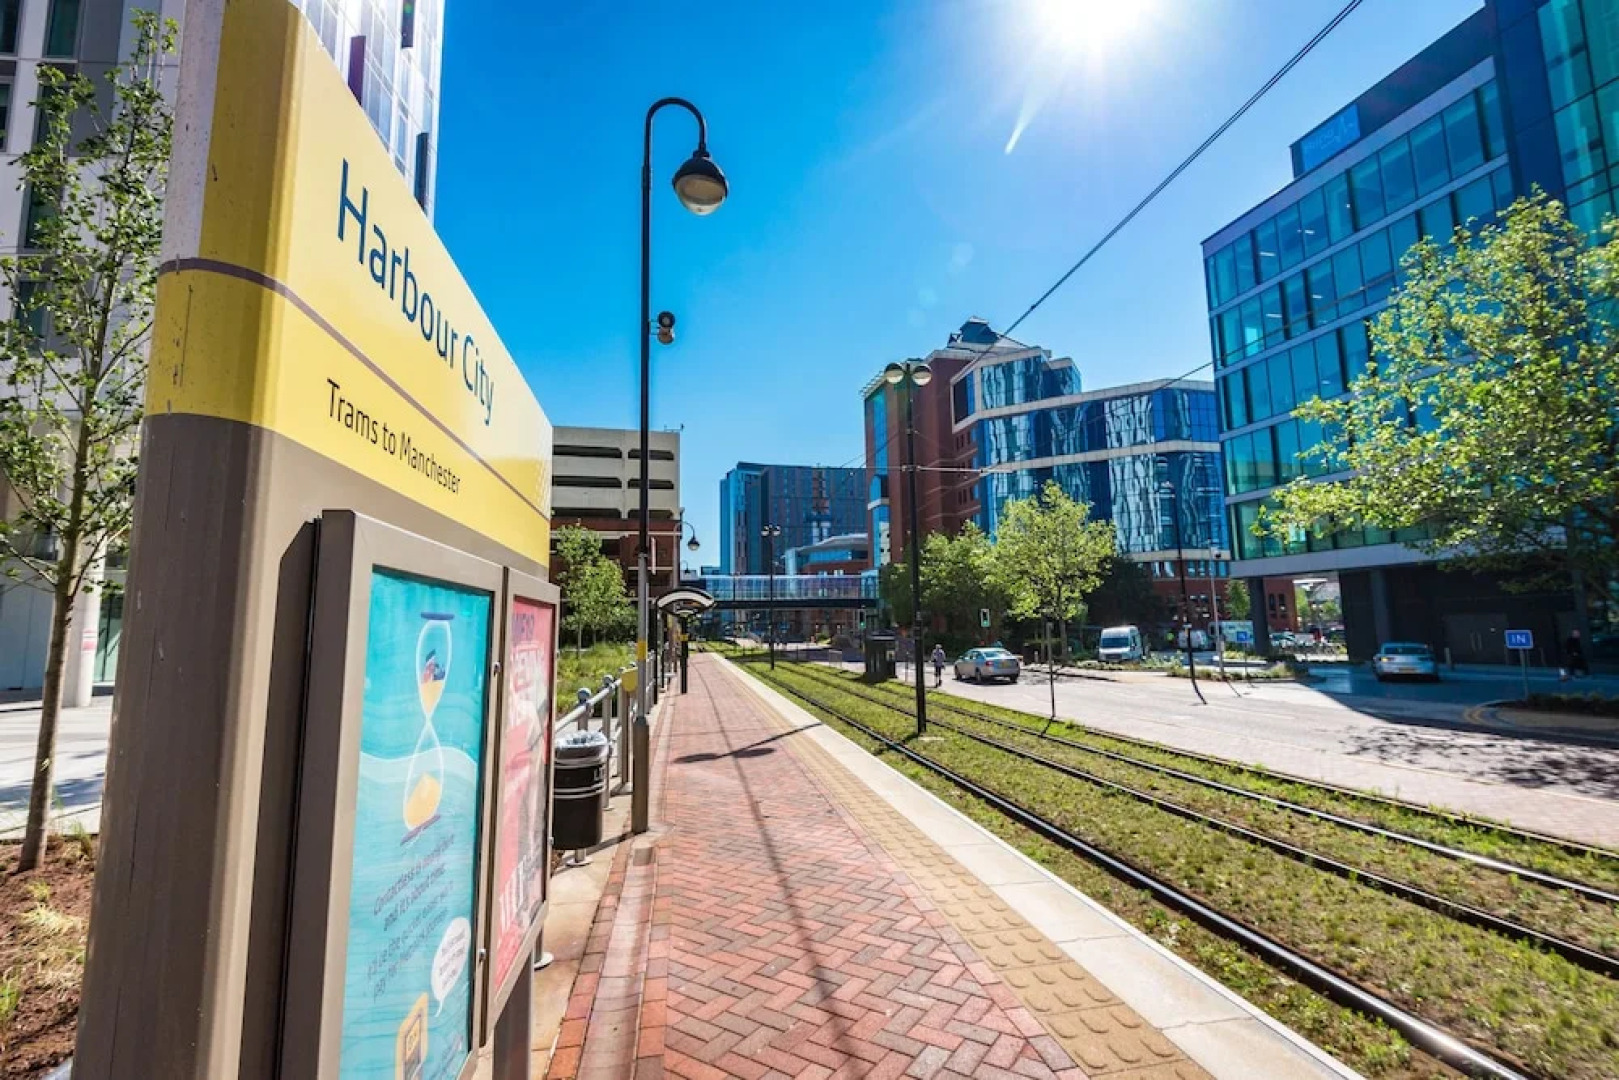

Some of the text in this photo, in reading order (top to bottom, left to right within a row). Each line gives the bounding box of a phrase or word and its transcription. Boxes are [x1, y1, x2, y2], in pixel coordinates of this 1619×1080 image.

[337, 157, 495, 426] Harbour City
[326, 377, 461, 495] Trams to Manchester
[1511, 634, 1526, 644] IN
